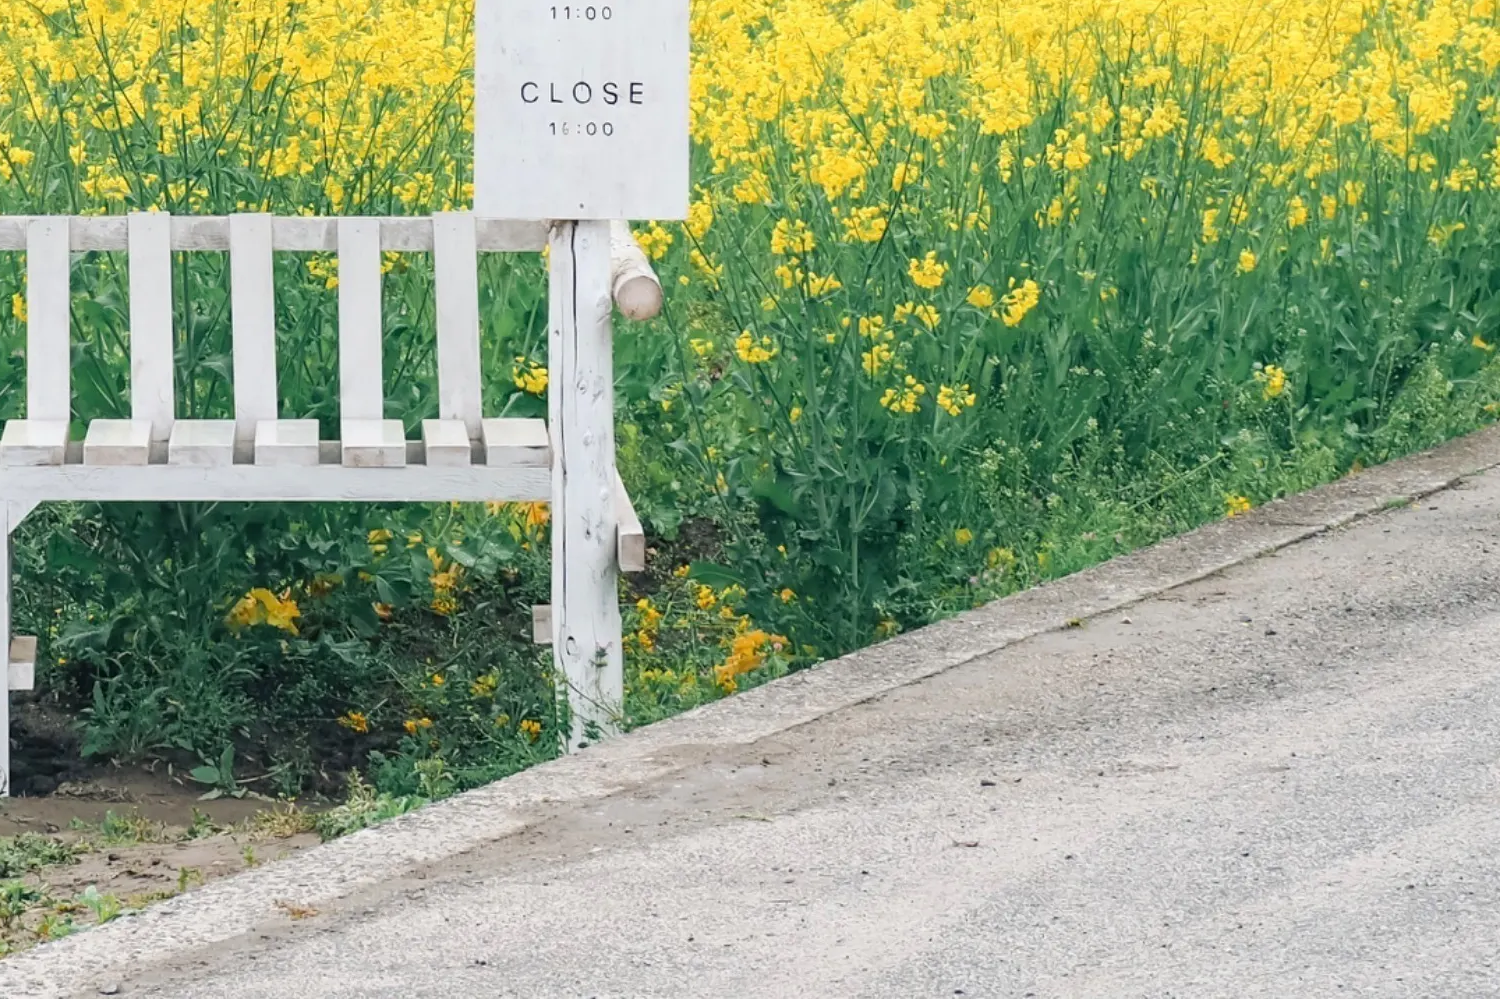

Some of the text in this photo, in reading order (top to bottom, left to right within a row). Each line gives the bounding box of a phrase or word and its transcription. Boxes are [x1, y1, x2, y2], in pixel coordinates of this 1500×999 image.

[549, 5, 613, 21] 11:00
[520, 80, 645, 106] CLOSE
[548, 121, 614, 137] 16:00
